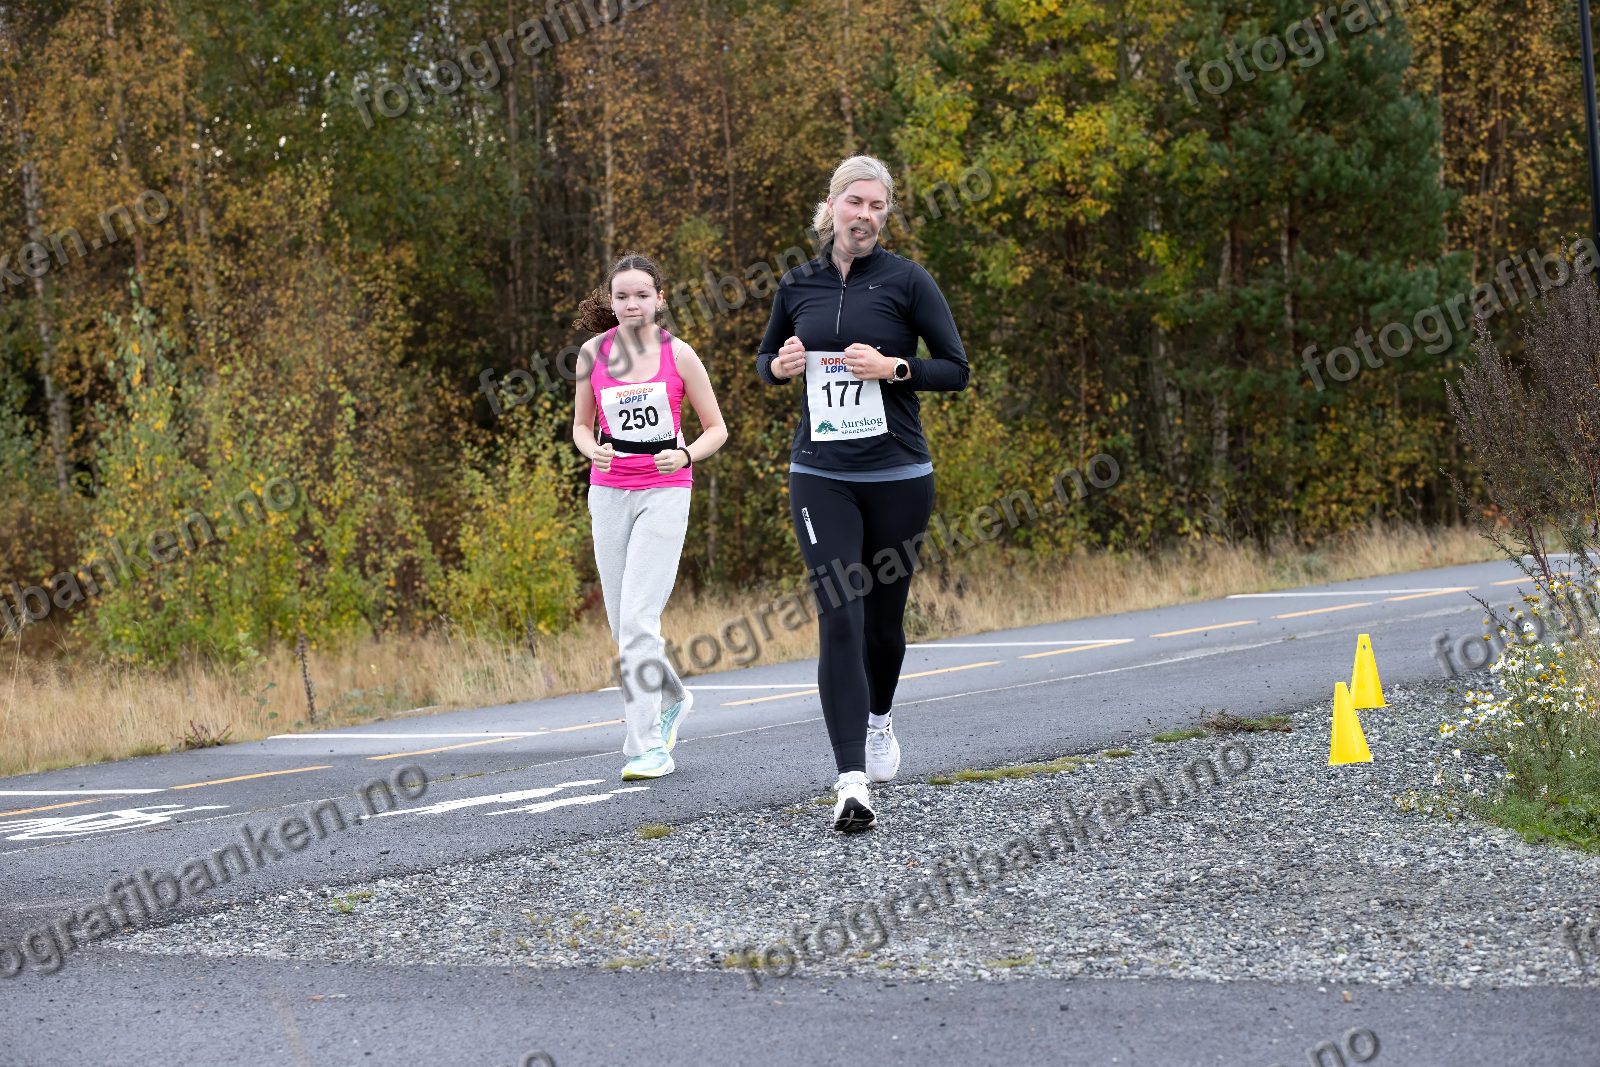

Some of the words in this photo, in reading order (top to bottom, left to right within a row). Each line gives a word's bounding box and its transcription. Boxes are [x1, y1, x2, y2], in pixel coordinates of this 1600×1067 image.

[821, 357, 847, 365] NORG
[616, 387, 653, 398] NORGES
[822, 381, 863, 407] 177
[620, 393, 648, 404] LØPET
[618, 405, 658, 431] 250
[841, 417, 883, 429] Aurskog
